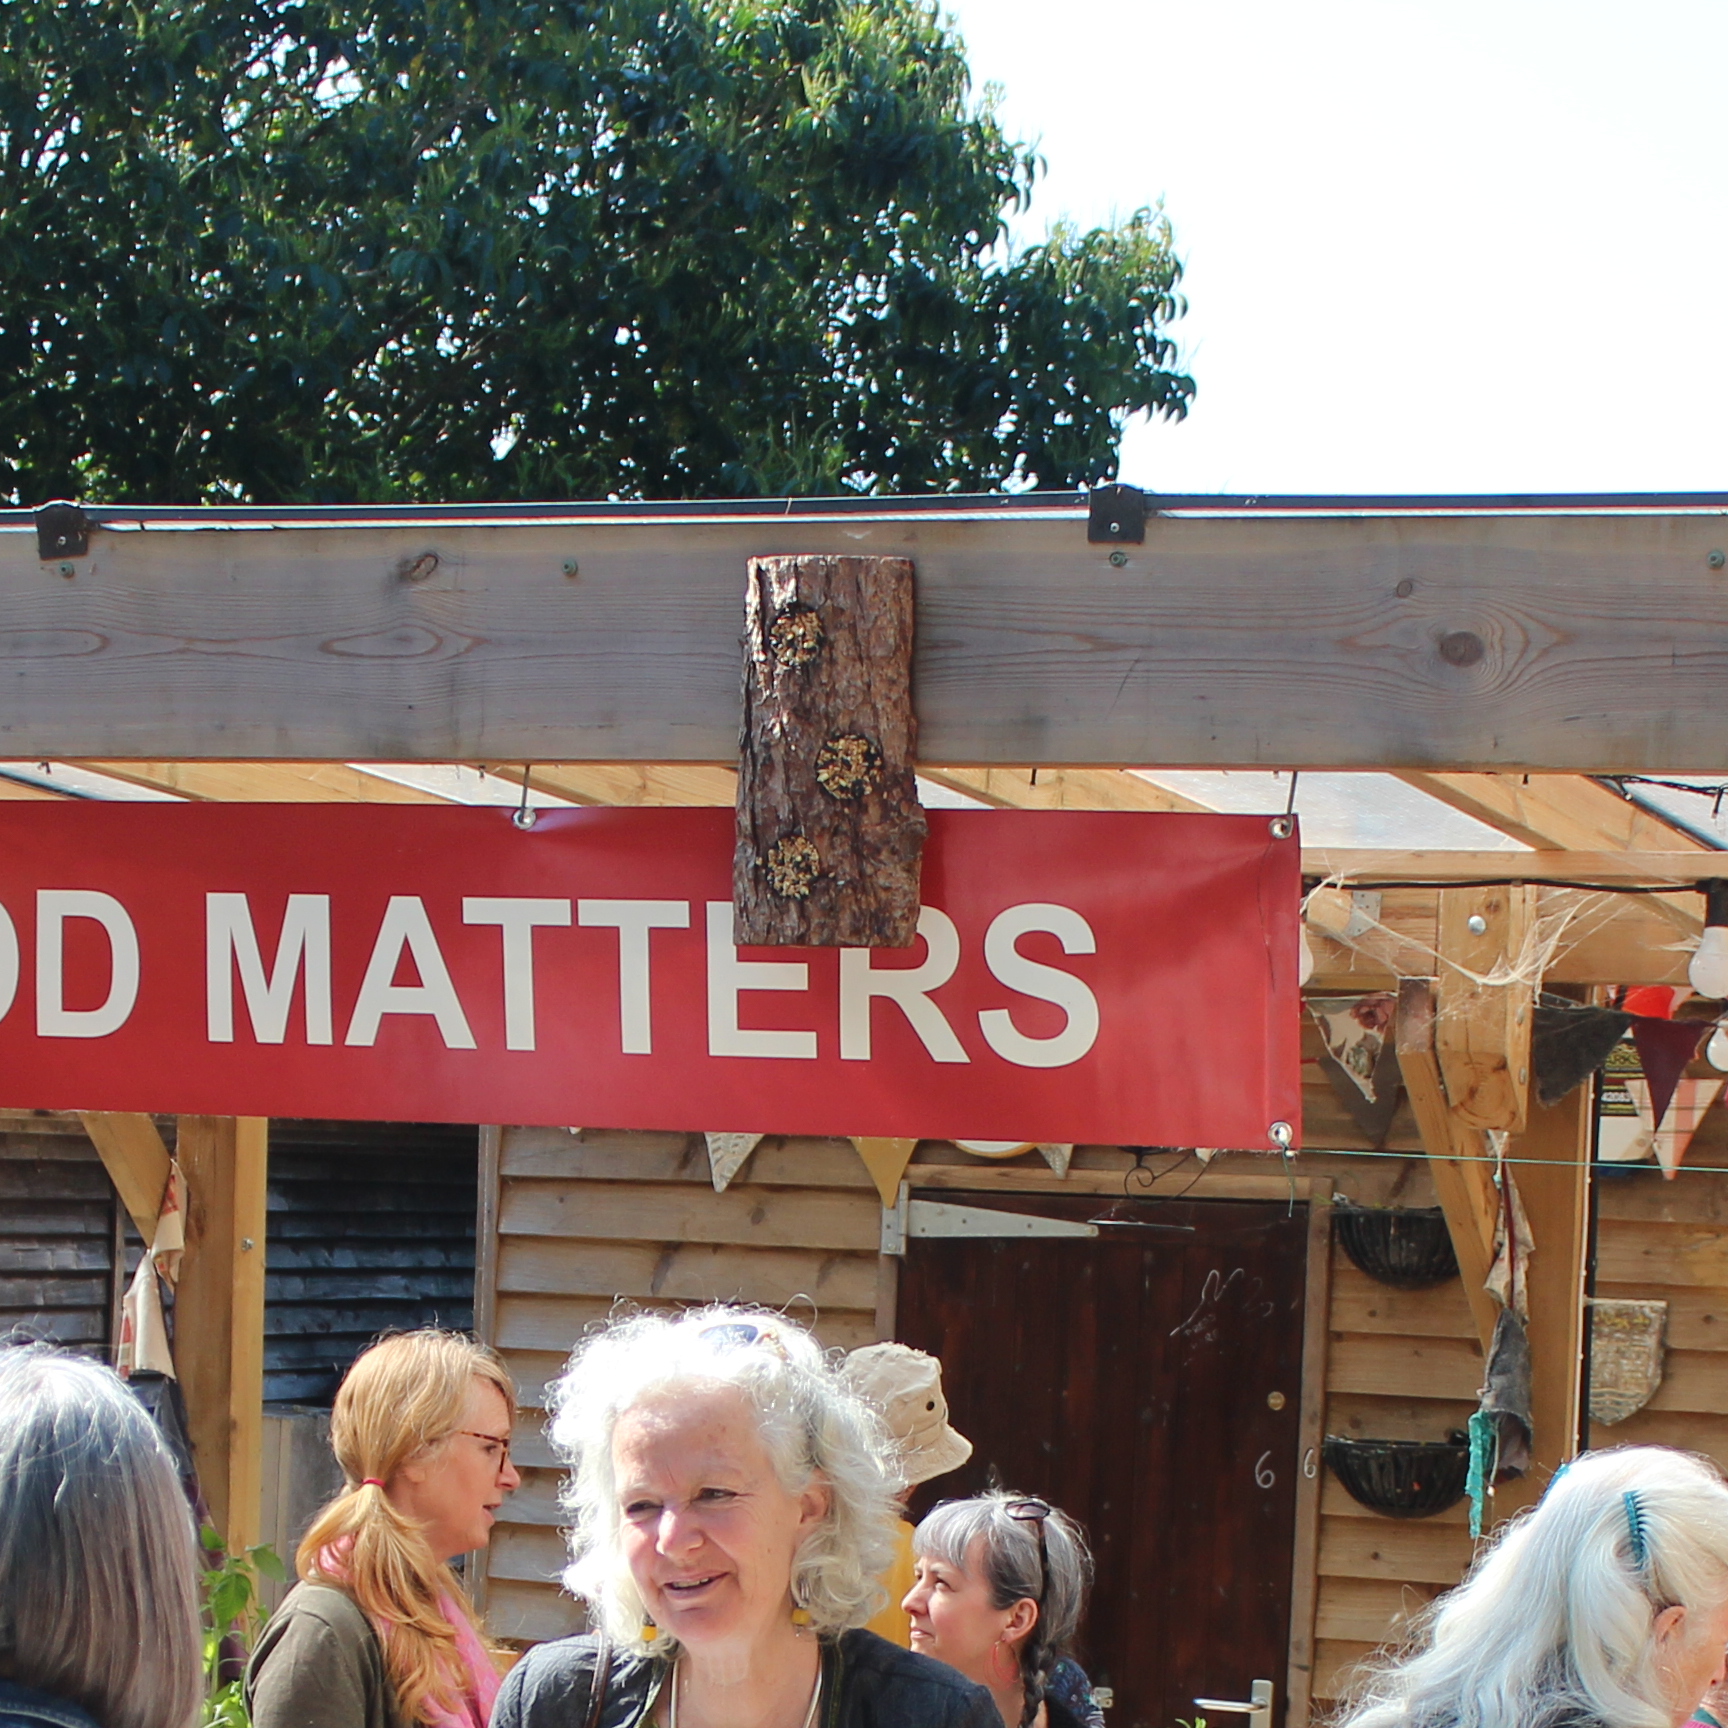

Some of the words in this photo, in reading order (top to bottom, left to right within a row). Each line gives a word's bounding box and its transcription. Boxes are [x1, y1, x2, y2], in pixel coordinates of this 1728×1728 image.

[205, 892, 1100, 1068] MATTERS
[1255, 1449, 1275, 1489] 6
[1303, 1447, 1317, 1478] 6
